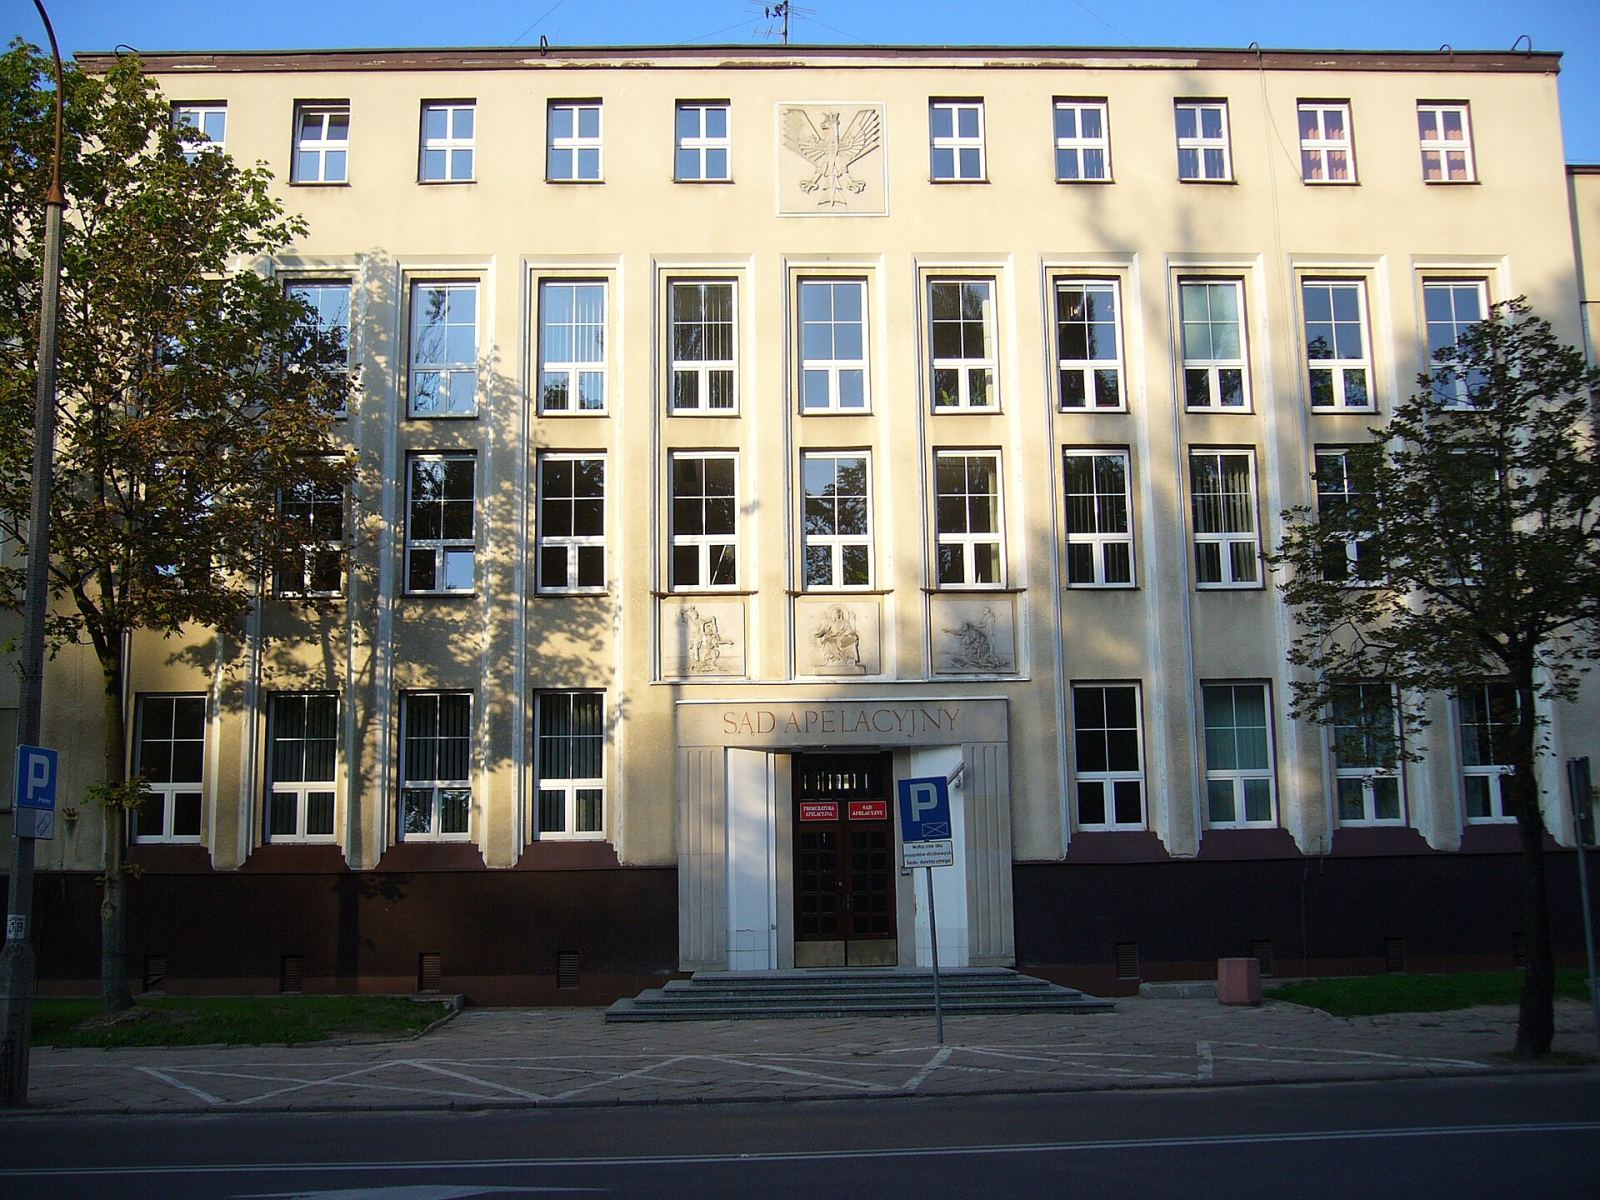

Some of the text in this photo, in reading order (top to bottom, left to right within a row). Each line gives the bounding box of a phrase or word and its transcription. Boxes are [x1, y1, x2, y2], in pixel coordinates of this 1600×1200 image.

[723, 708, 960, 738] SĄD APELACYJNY
[27, 753, 49, 799] P
[910, 782, 938, 822] P
